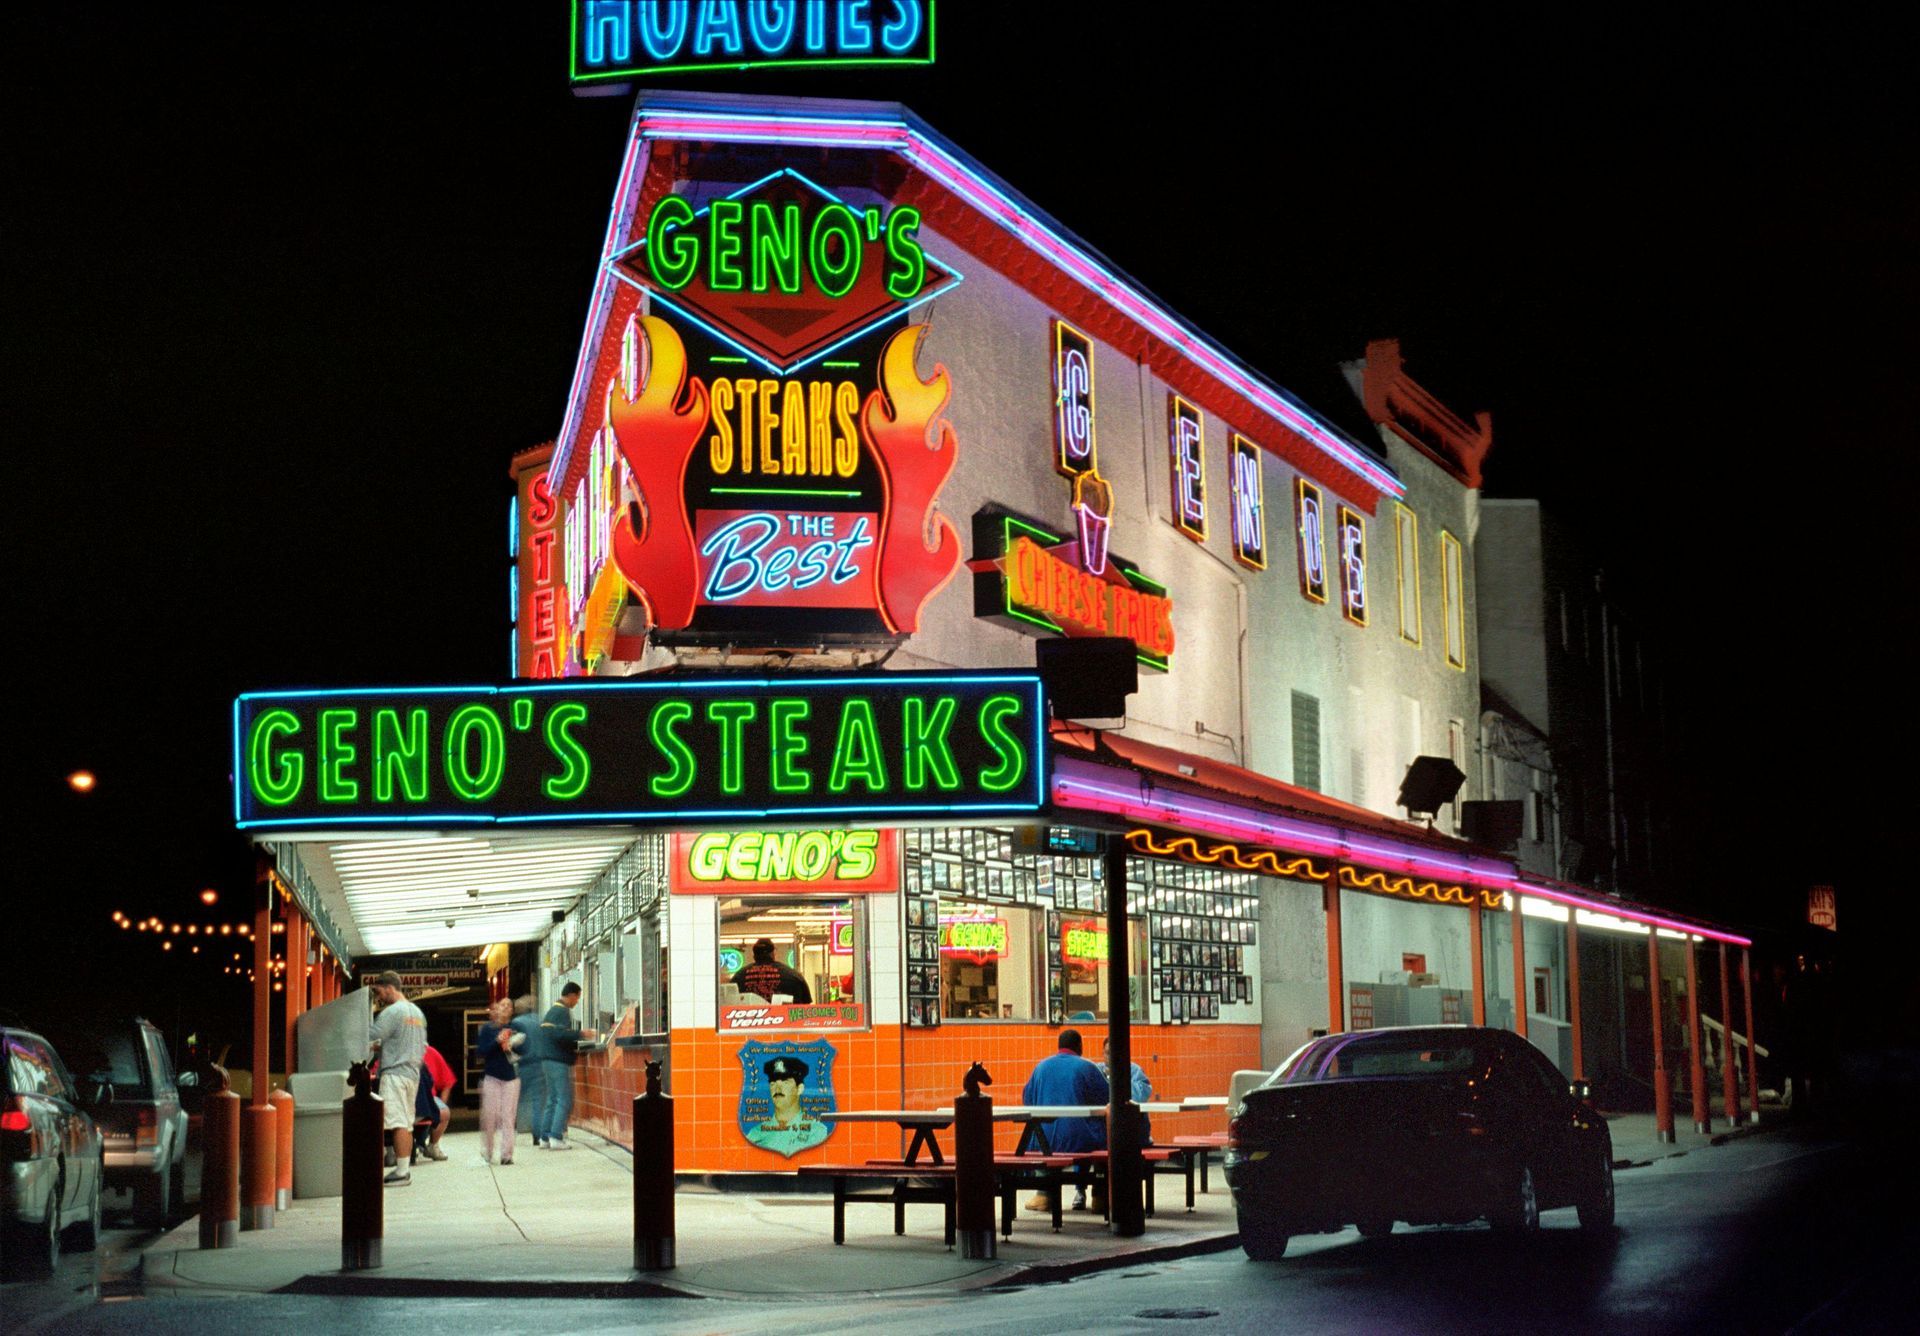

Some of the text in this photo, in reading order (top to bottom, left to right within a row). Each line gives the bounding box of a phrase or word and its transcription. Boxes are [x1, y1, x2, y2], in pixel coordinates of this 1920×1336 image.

[647, 197, 925, 299] GENO'S
[709, 377, 860, 477] STEAKS
[702, 512, 874, 601] Best
[787, 514, 834, 537] THE
[1017, 536, 1175, 656] CHEESE FRIES
[249, 697, 1024, 805] GENO'S STEAKS
[689, 829, 879, 882] GENO'S
[424, 975, 446, 986] SHOP
[788, 1007, 858, 1022] WELCOMES YOU
